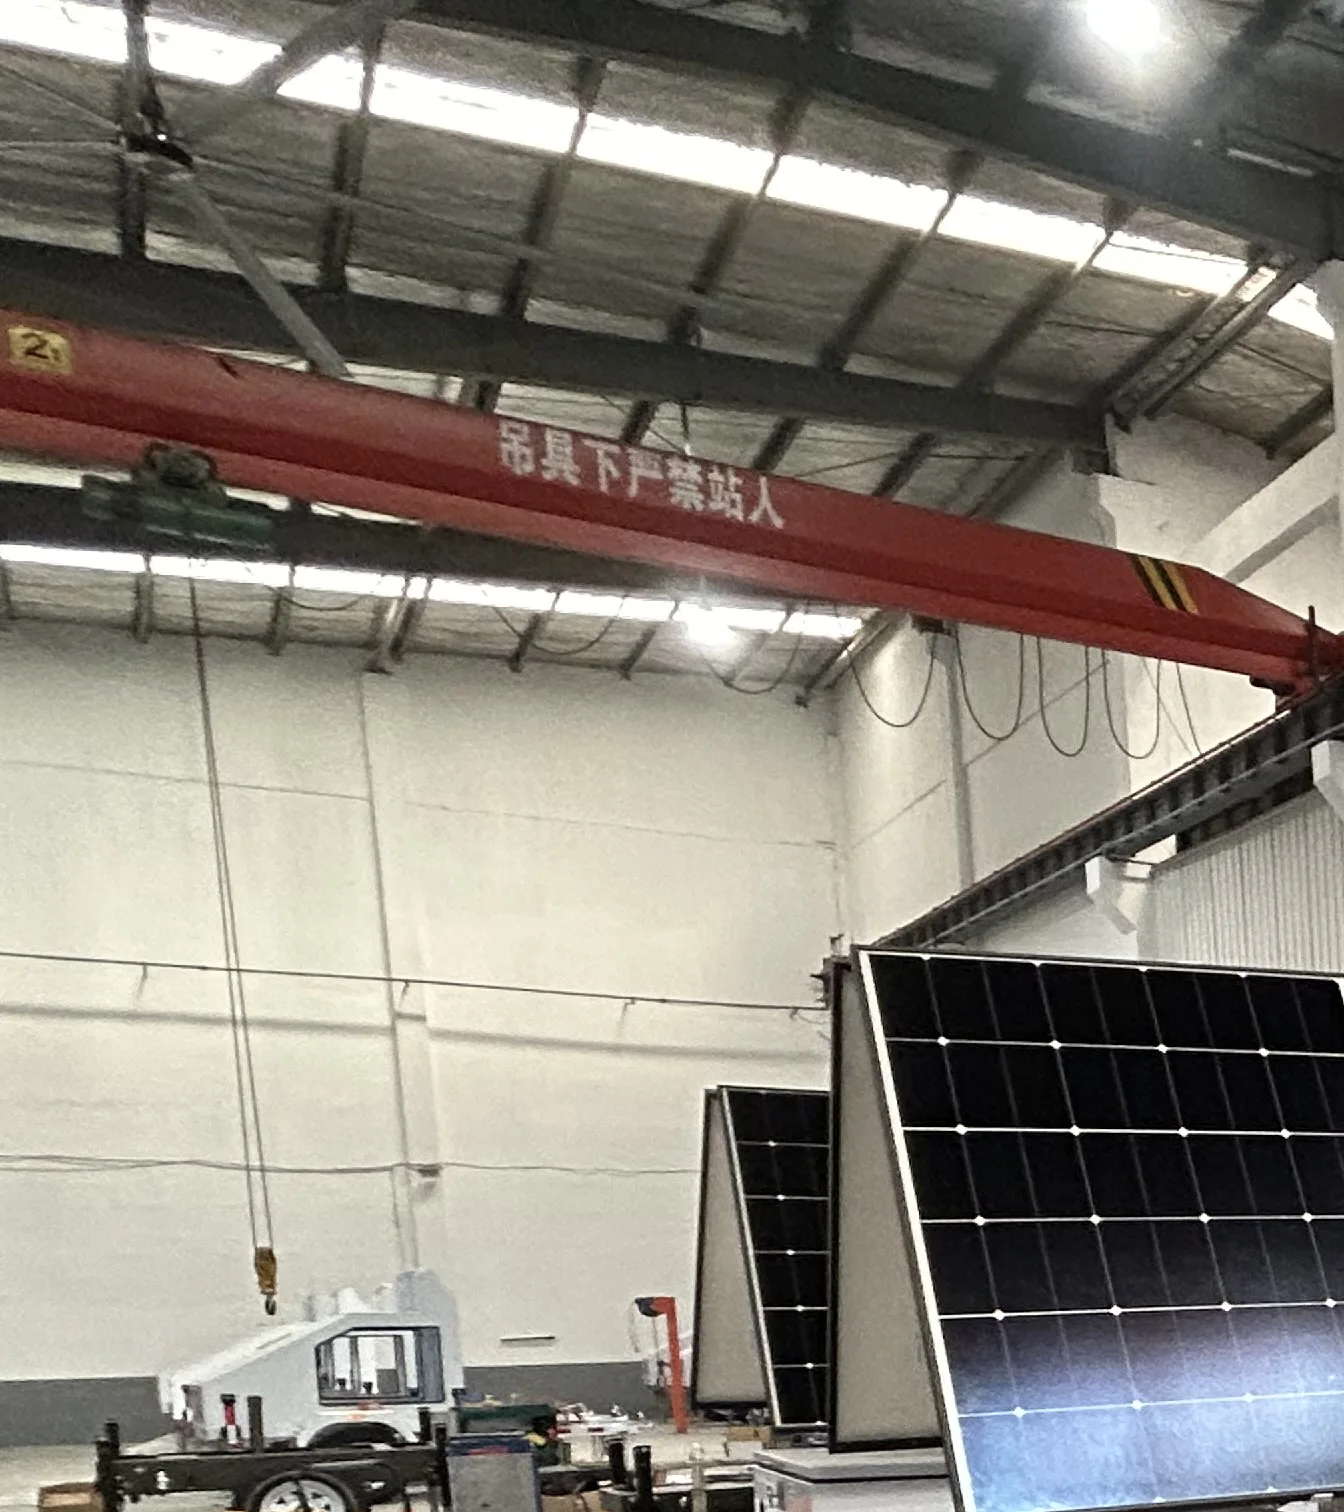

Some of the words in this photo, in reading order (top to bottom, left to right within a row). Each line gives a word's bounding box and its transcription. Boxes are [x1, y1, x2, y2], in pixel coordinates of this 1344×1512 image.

[500, 420, 784, 530] 吊具下严禁站人
